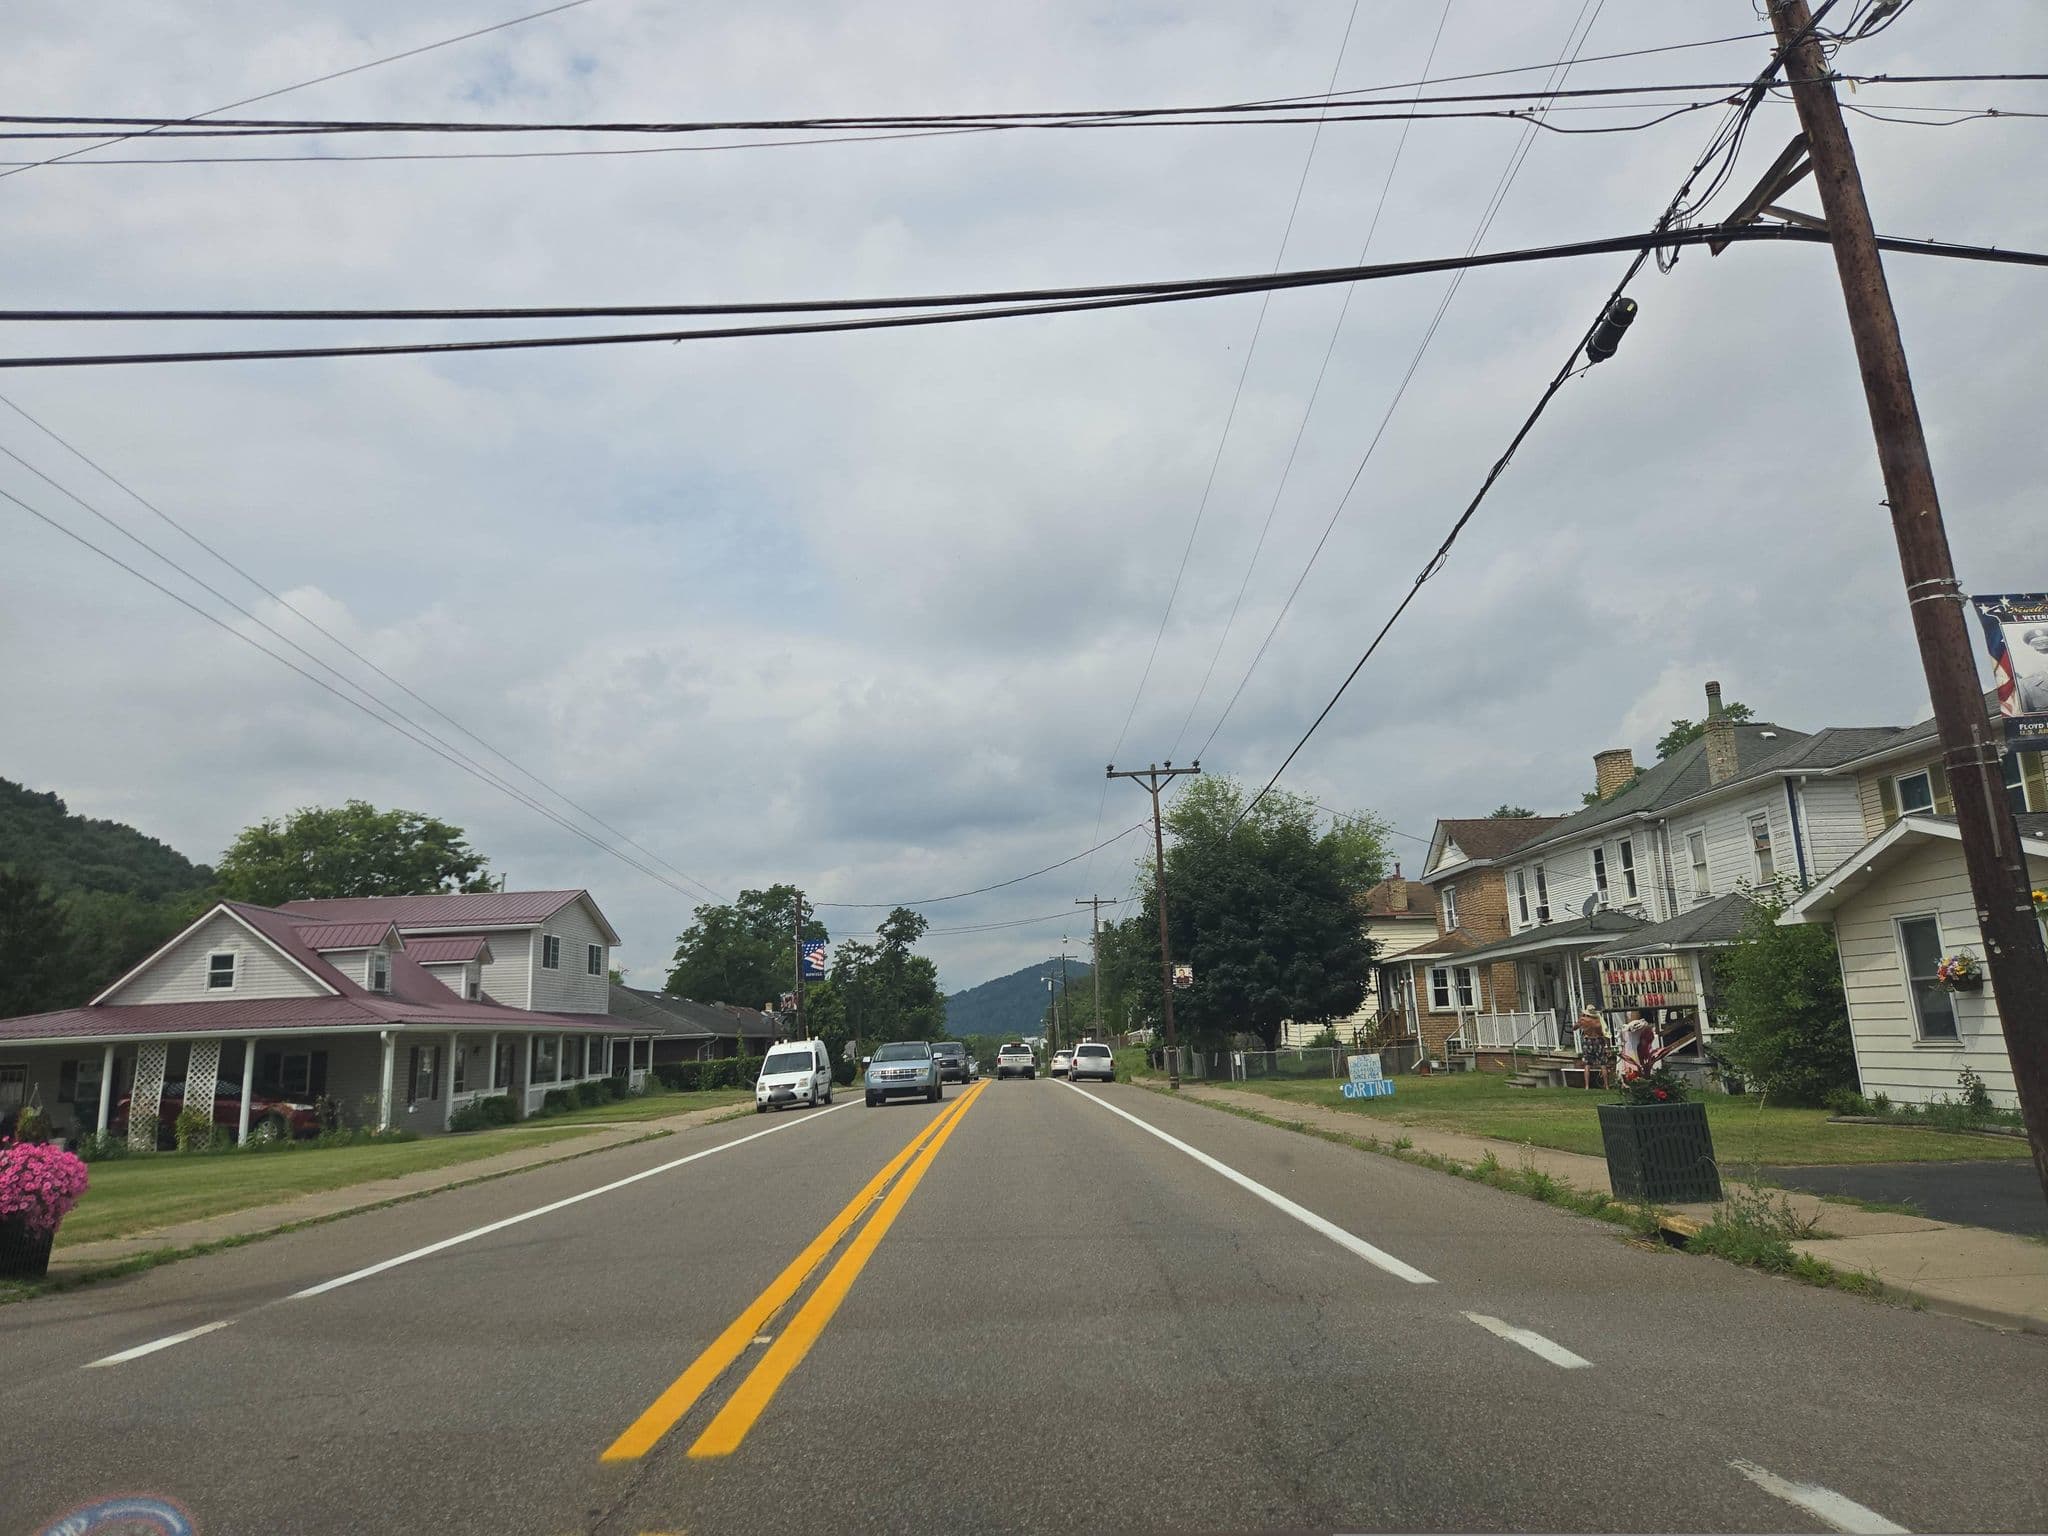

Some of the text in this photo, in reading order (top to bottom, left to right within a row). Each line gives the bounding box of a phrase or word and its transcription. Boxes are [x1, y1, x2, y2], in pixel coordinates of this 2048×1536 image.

[2019, 723, 2044, 731] FLOYD
[1603, 956, 1665, 971] WINDOW TINT
[1641, 981, 1679, 994] FLORIDA
[1612, 995, 1639, 1008] SINCE
[1344, 1080, 1393, 1098] CAR TINT
